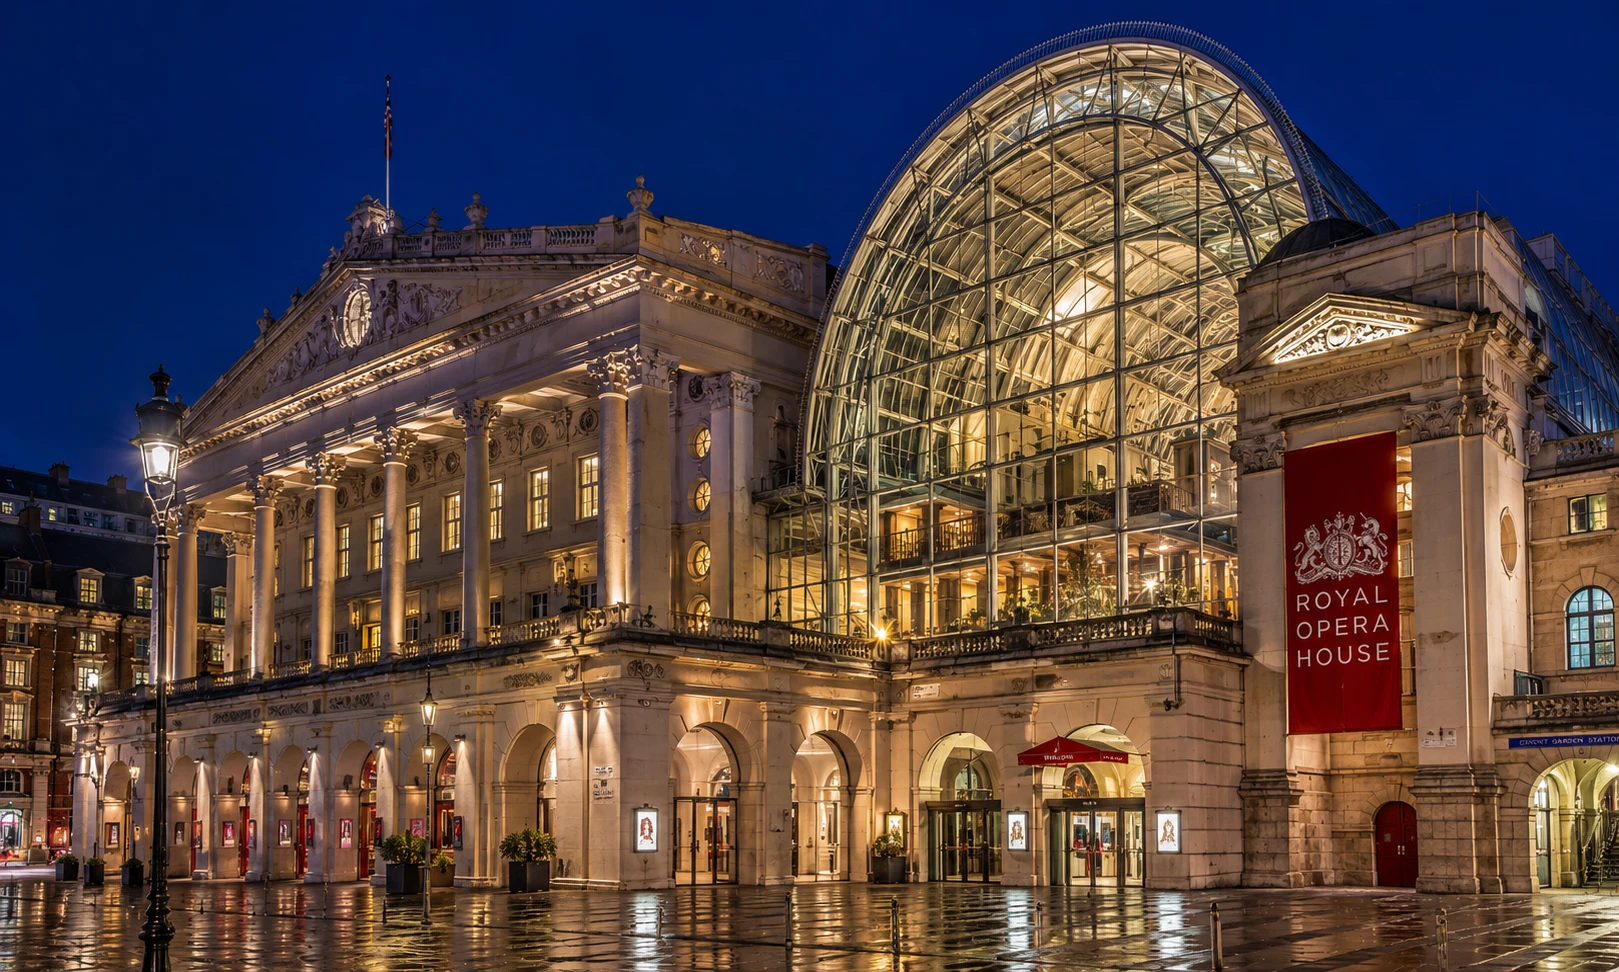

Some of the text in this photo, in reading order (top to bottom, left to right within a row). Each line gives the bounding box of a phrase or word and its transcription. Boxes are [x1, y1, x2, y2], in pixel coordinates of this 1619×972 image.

[1296, 585, 1388, 612] ROYAL
[1296, 613, 1390, 640] OPERA
[1297, 642, 1390, 668] HOUSE
